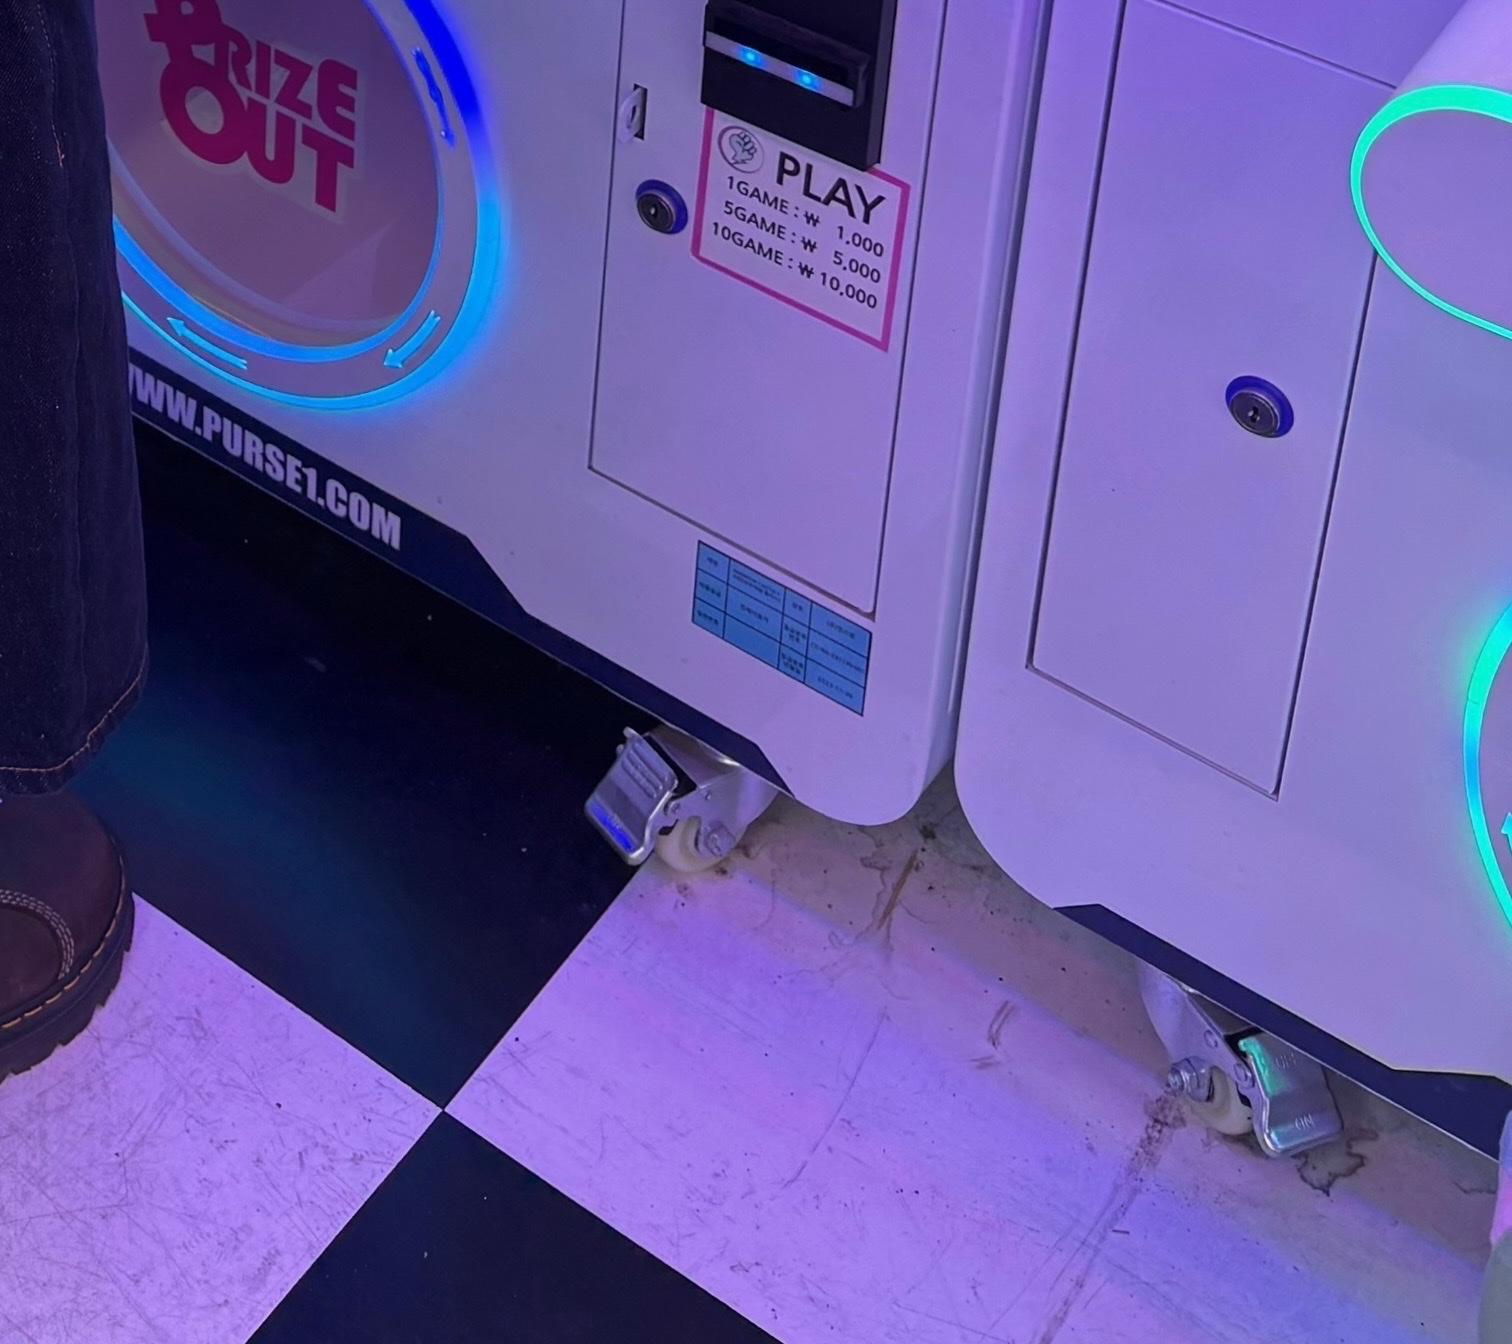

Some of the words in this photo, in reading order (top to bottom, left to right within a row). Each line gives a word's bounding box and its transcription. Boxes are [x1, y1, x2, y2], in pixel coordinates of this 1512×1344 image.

[159, 57, 355, 213] OUT
[727, 175, 789, 214] 1GAME
[776, 151, 886, 225] PLAY
[712, 221, 784, 266] 10GAME
[723, 200, 786, 240] 5GAME
[129, 362, 401, 551] WW.PURSE1.COM
